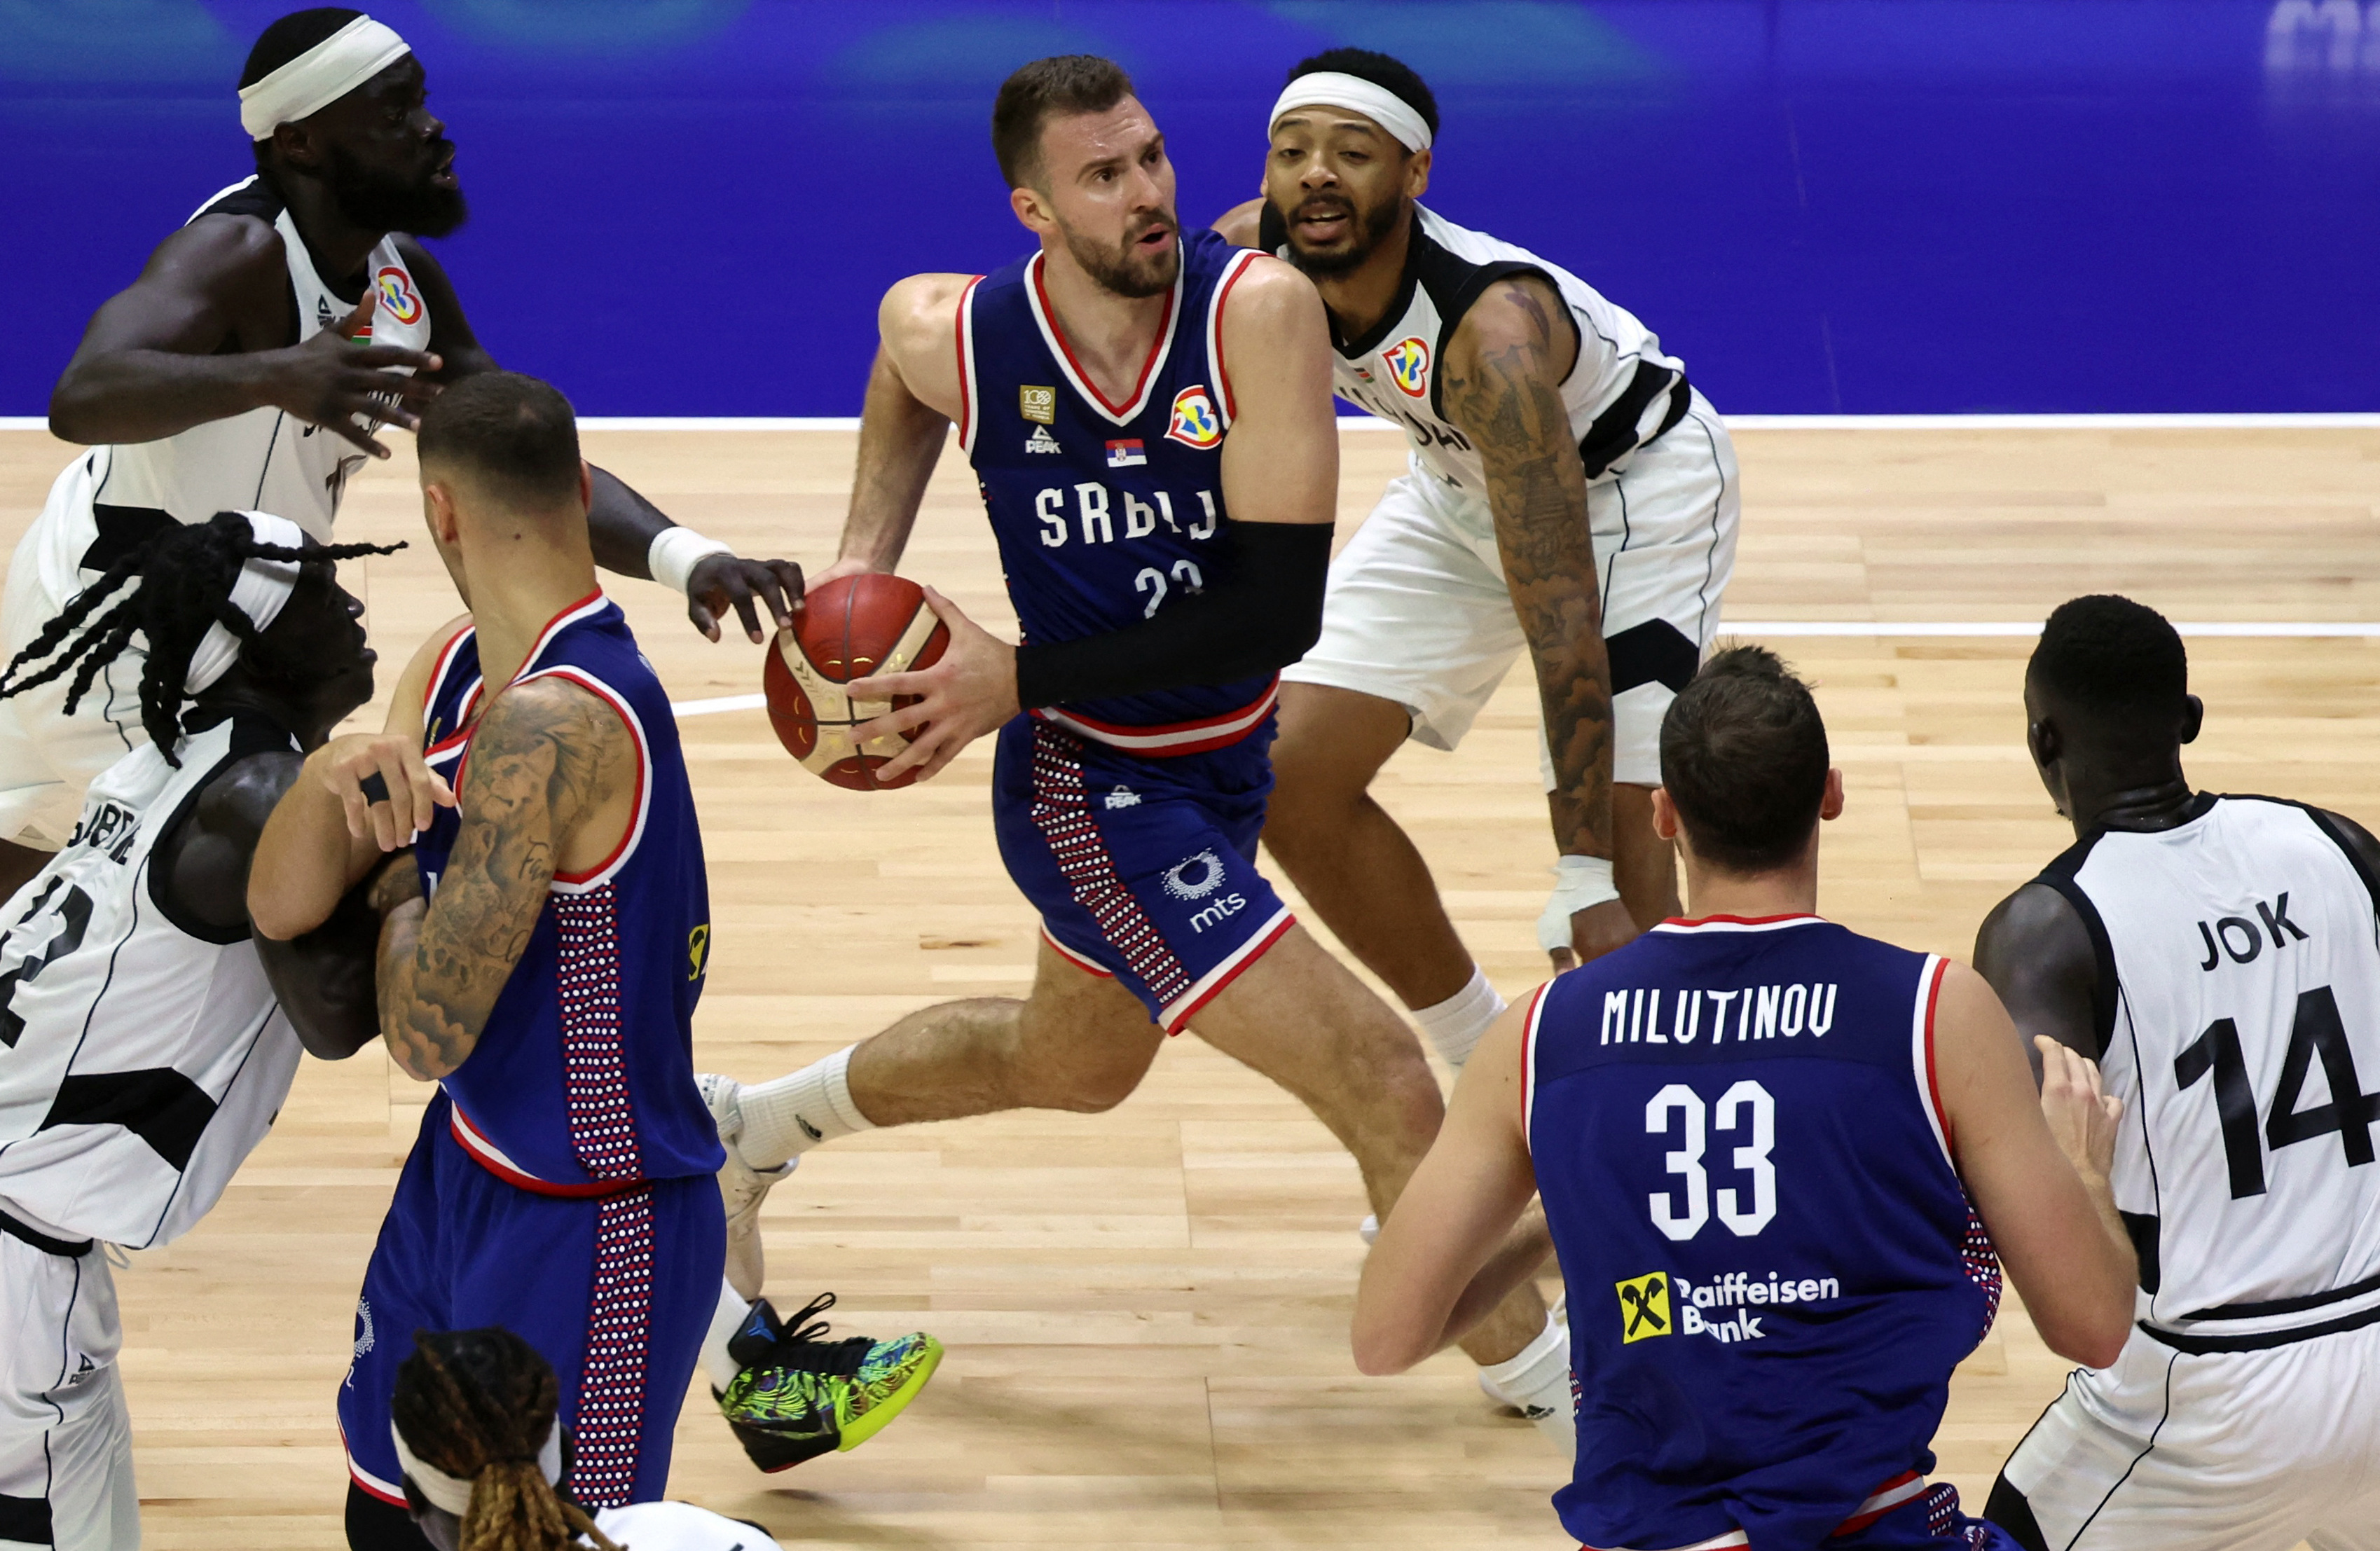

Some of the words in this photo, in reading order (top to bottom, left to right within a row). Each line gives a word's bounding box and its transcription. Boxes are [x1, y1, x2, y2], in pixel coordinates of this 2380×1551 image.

[1025, 439, 1062, 454] PEAK
[1035, 481, 1216, 547] SRBIJ
[1104, 794, 1142, 810] PEAK
[1189, 892, 1247, 934] mts
[2197, 891, 2310, 972] JOK
[2174, 984, 2380, 1200] 14
[1645, 1080, 1777, 1241] 33
